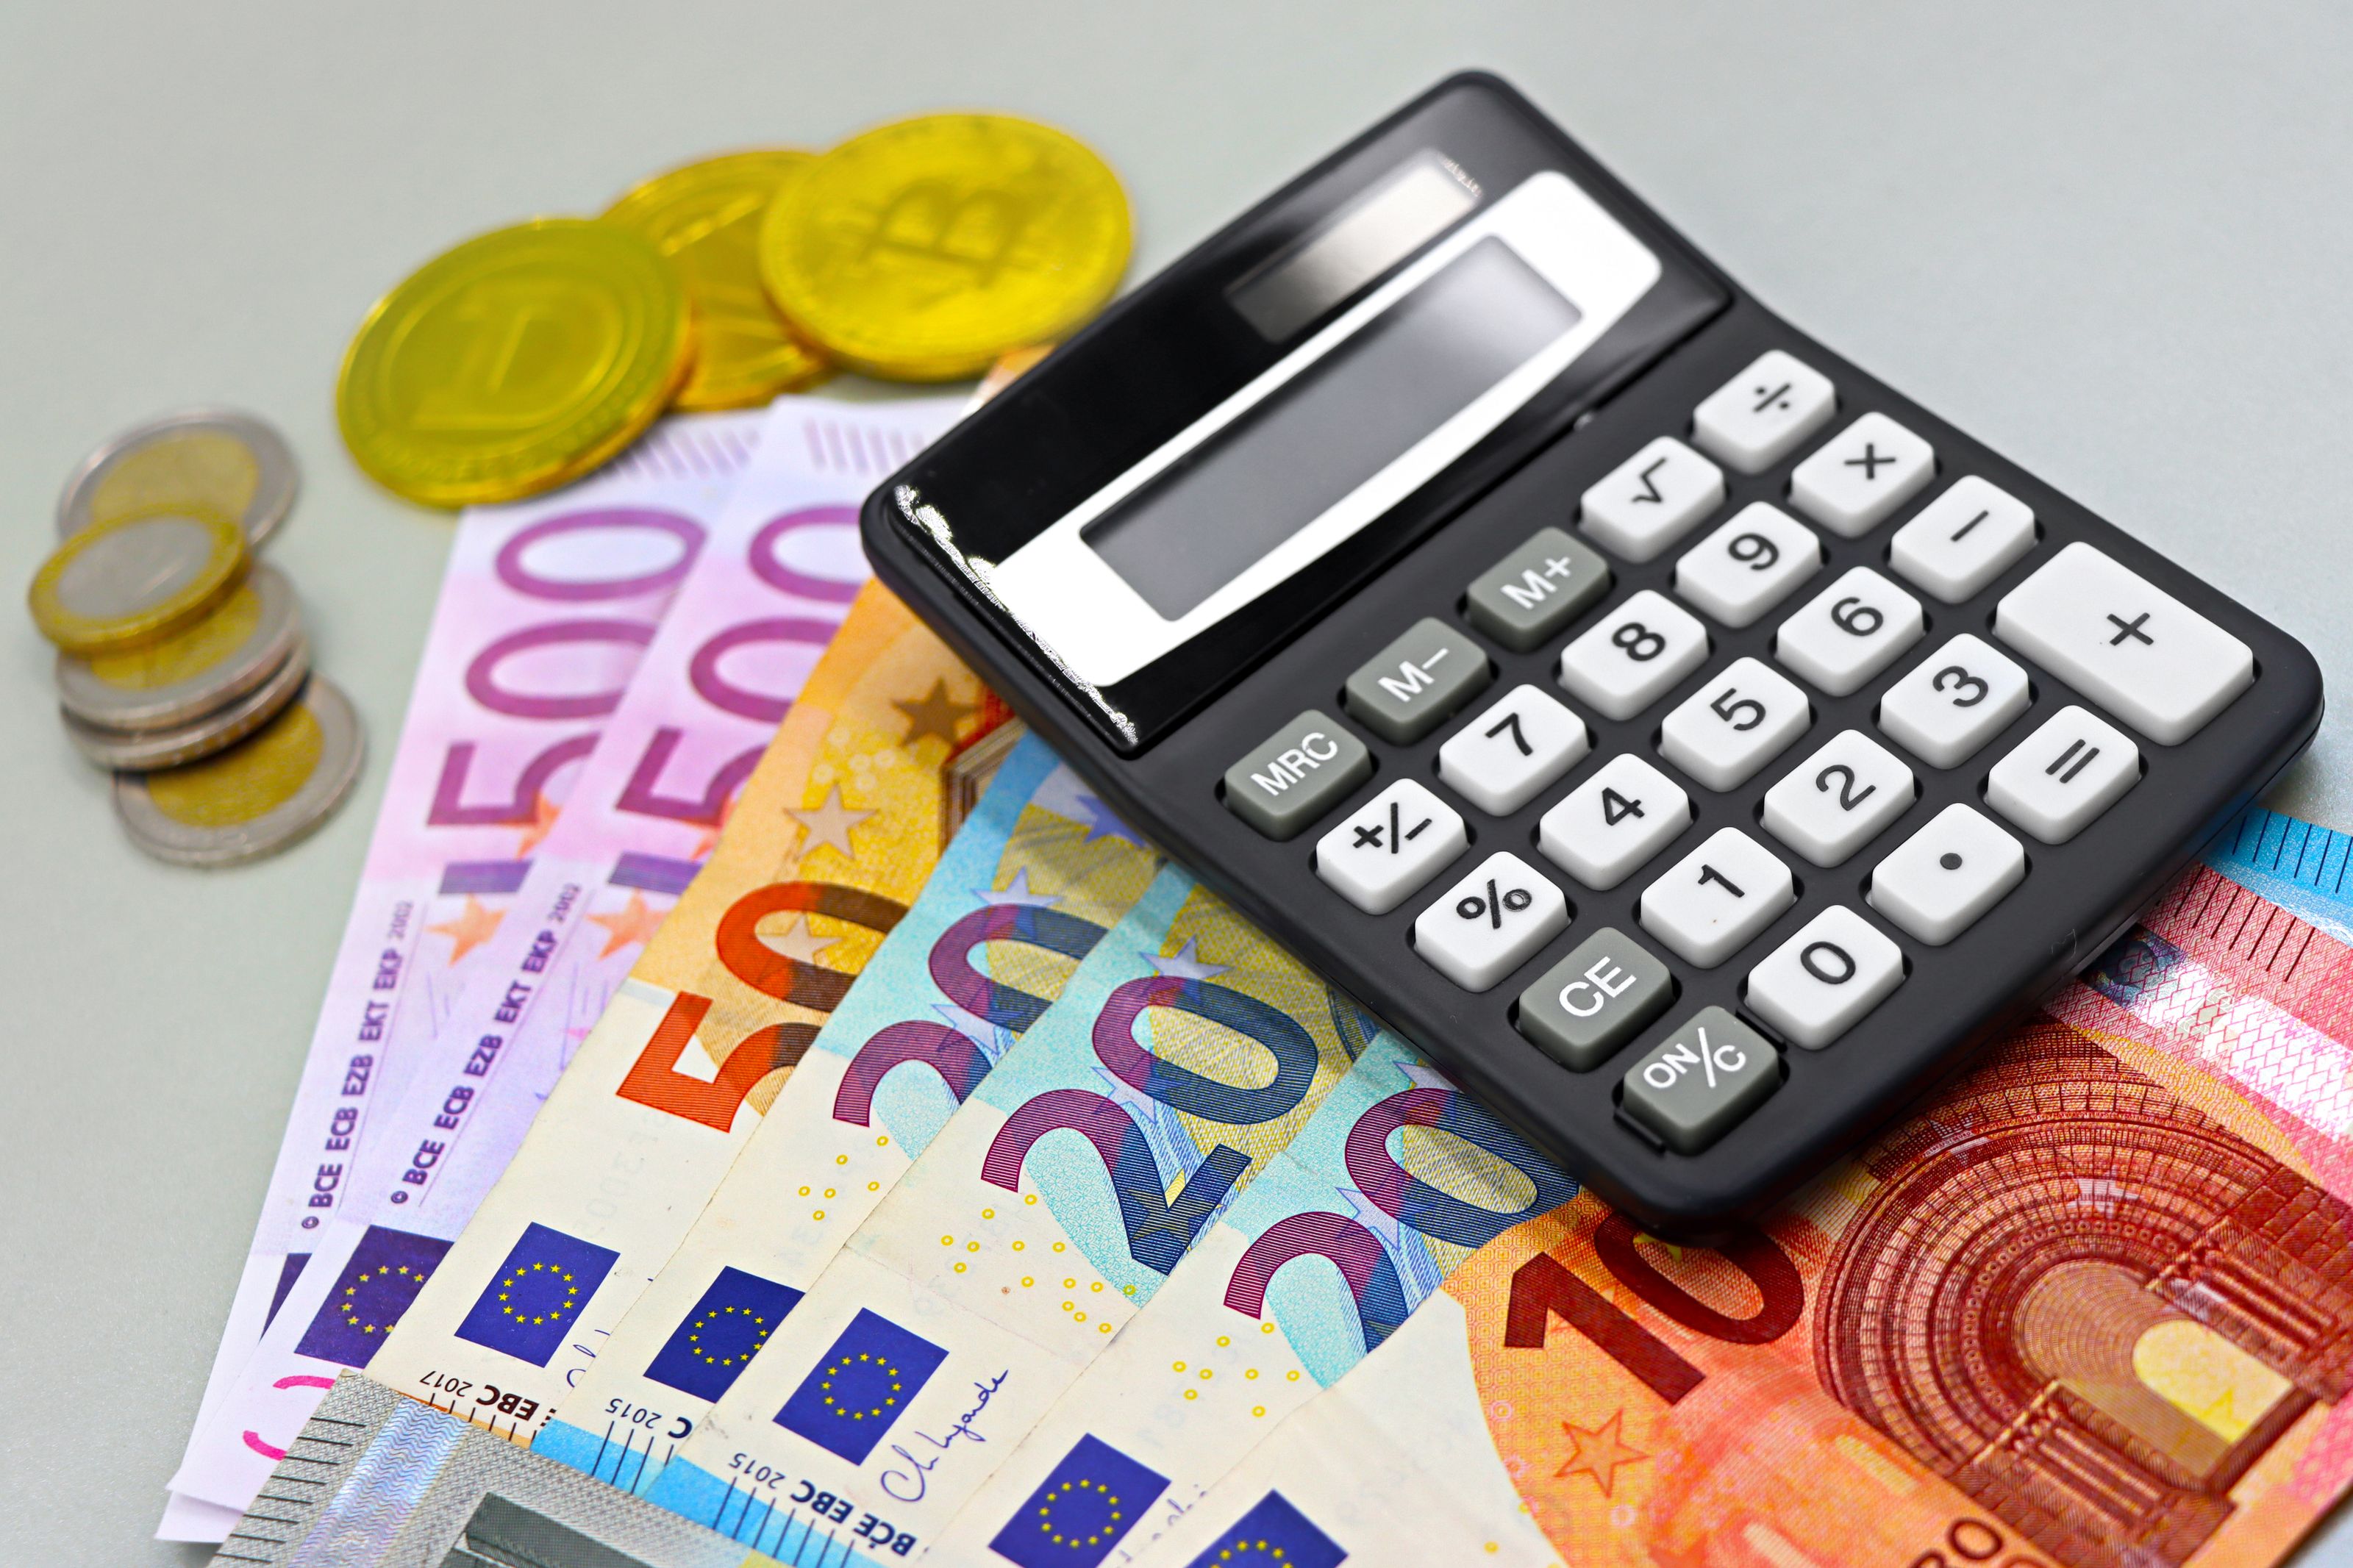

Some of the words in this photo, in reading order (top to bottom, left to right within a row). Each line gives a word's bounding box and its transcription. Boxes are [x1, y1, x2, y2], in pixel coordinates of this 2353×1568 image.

[1728, 533, 1779, 571] 9
[1500, 556, 1571, 609] M+
[1831, 597, 1883, 636] 6
[1612, 622, 1666, 662] 8
[426, 506, 708, 826] 500
[1378, 648, 1449, 702] M-
[1932, 665, 1988, 708] 3
[1710, 688, 1765, 731] 5
[1485, 712, 1533, 756] 7
[1251, 732, 1338, 796] MRC
[1602, 787, 1646, 826] 4
[1815, 764, 1877, 812] 2
[1698, 863, 1745, 898] 1
[1456, 878, 1532, 929] %
[373, 947, 403, 990] EKP
[1800, 940, 1856, 985] 0
[615, 880, 910, 1133] 50
[1558, 956, 1637, 1017] CE
[358, 1000, 390, 1041] EKT
[341, 1053, 374, 1096] EZB
[402, 1139, 445, 1186] BCE
[434, 1084, 475, 1130] ECB
[463, 1034, 503, 1077] EZB
[494, 980, 532, 1024] EKT
[521, 928, 558, 974] EKP
[1642, 1026, 1747, 1089] ON/C
[325, 1106, 359, 1150] ECB
[981, 975, 1318, 1277] 20
[308, 1164, 343, 1207] BCE
[1223, 1087, 1579, 1354] 20
[1504, 1211, 1804, 1406] 10
[419, 1370, 473, 1397] 2017
[476, 1385, 540, 1422] EBC
[604, 1397, 663, 1431] 2015
[727, 1452, 786, 1490] 2015
[789, 1478, 855, 1525] EBC
